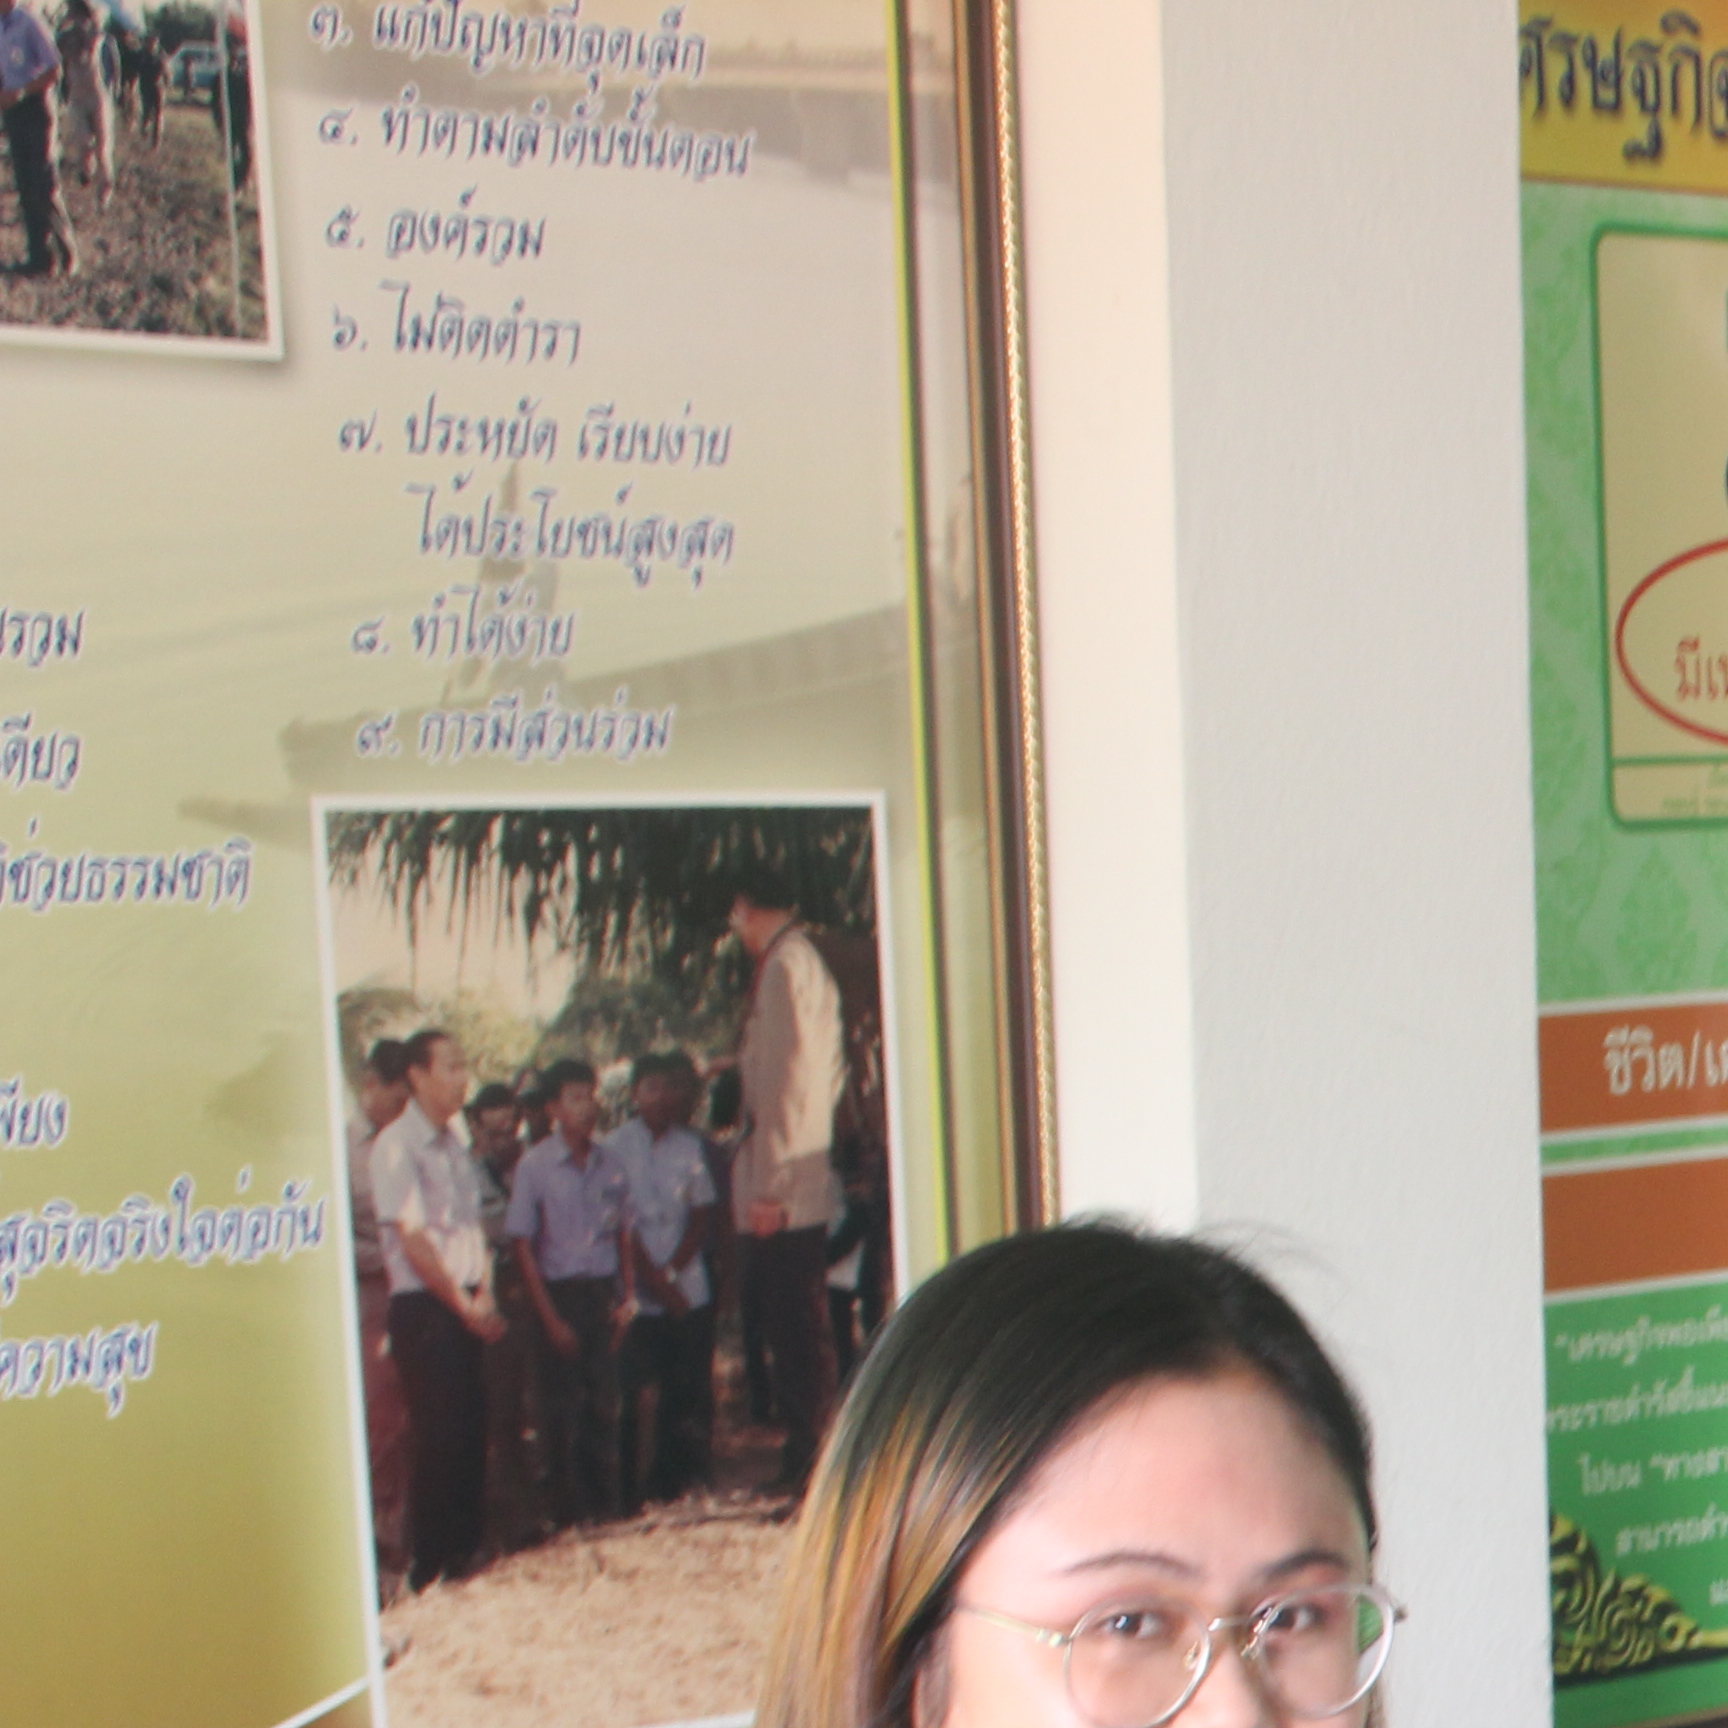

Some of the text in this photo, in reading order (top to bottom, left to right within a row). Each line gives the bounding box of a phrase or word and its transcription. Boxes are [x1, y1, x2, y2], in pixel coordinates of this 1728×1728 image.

[375, 0, 706, 94] แกปญหาทีจุดเล็ก
[382, 85, 757, 181] ทำตามลำดับขั้นตอน
[386, 184, 547, 265] องค์รวม
[378, 279, 582, 365] ไม่ติดตำรา
[404, 392, 559, 464] ประหยัด
[576, 400, 732, 469] เรียบง่าย
[404, 470, 735, 590] ได้ประโยชน์สูงสุด
[411, 580, 577, 667] ทำได้ง่าย
[418, 684, 677, 765] การมีส่วนร่วม
[0, 816, 255, 912] ช่วยธรรมชาติ
